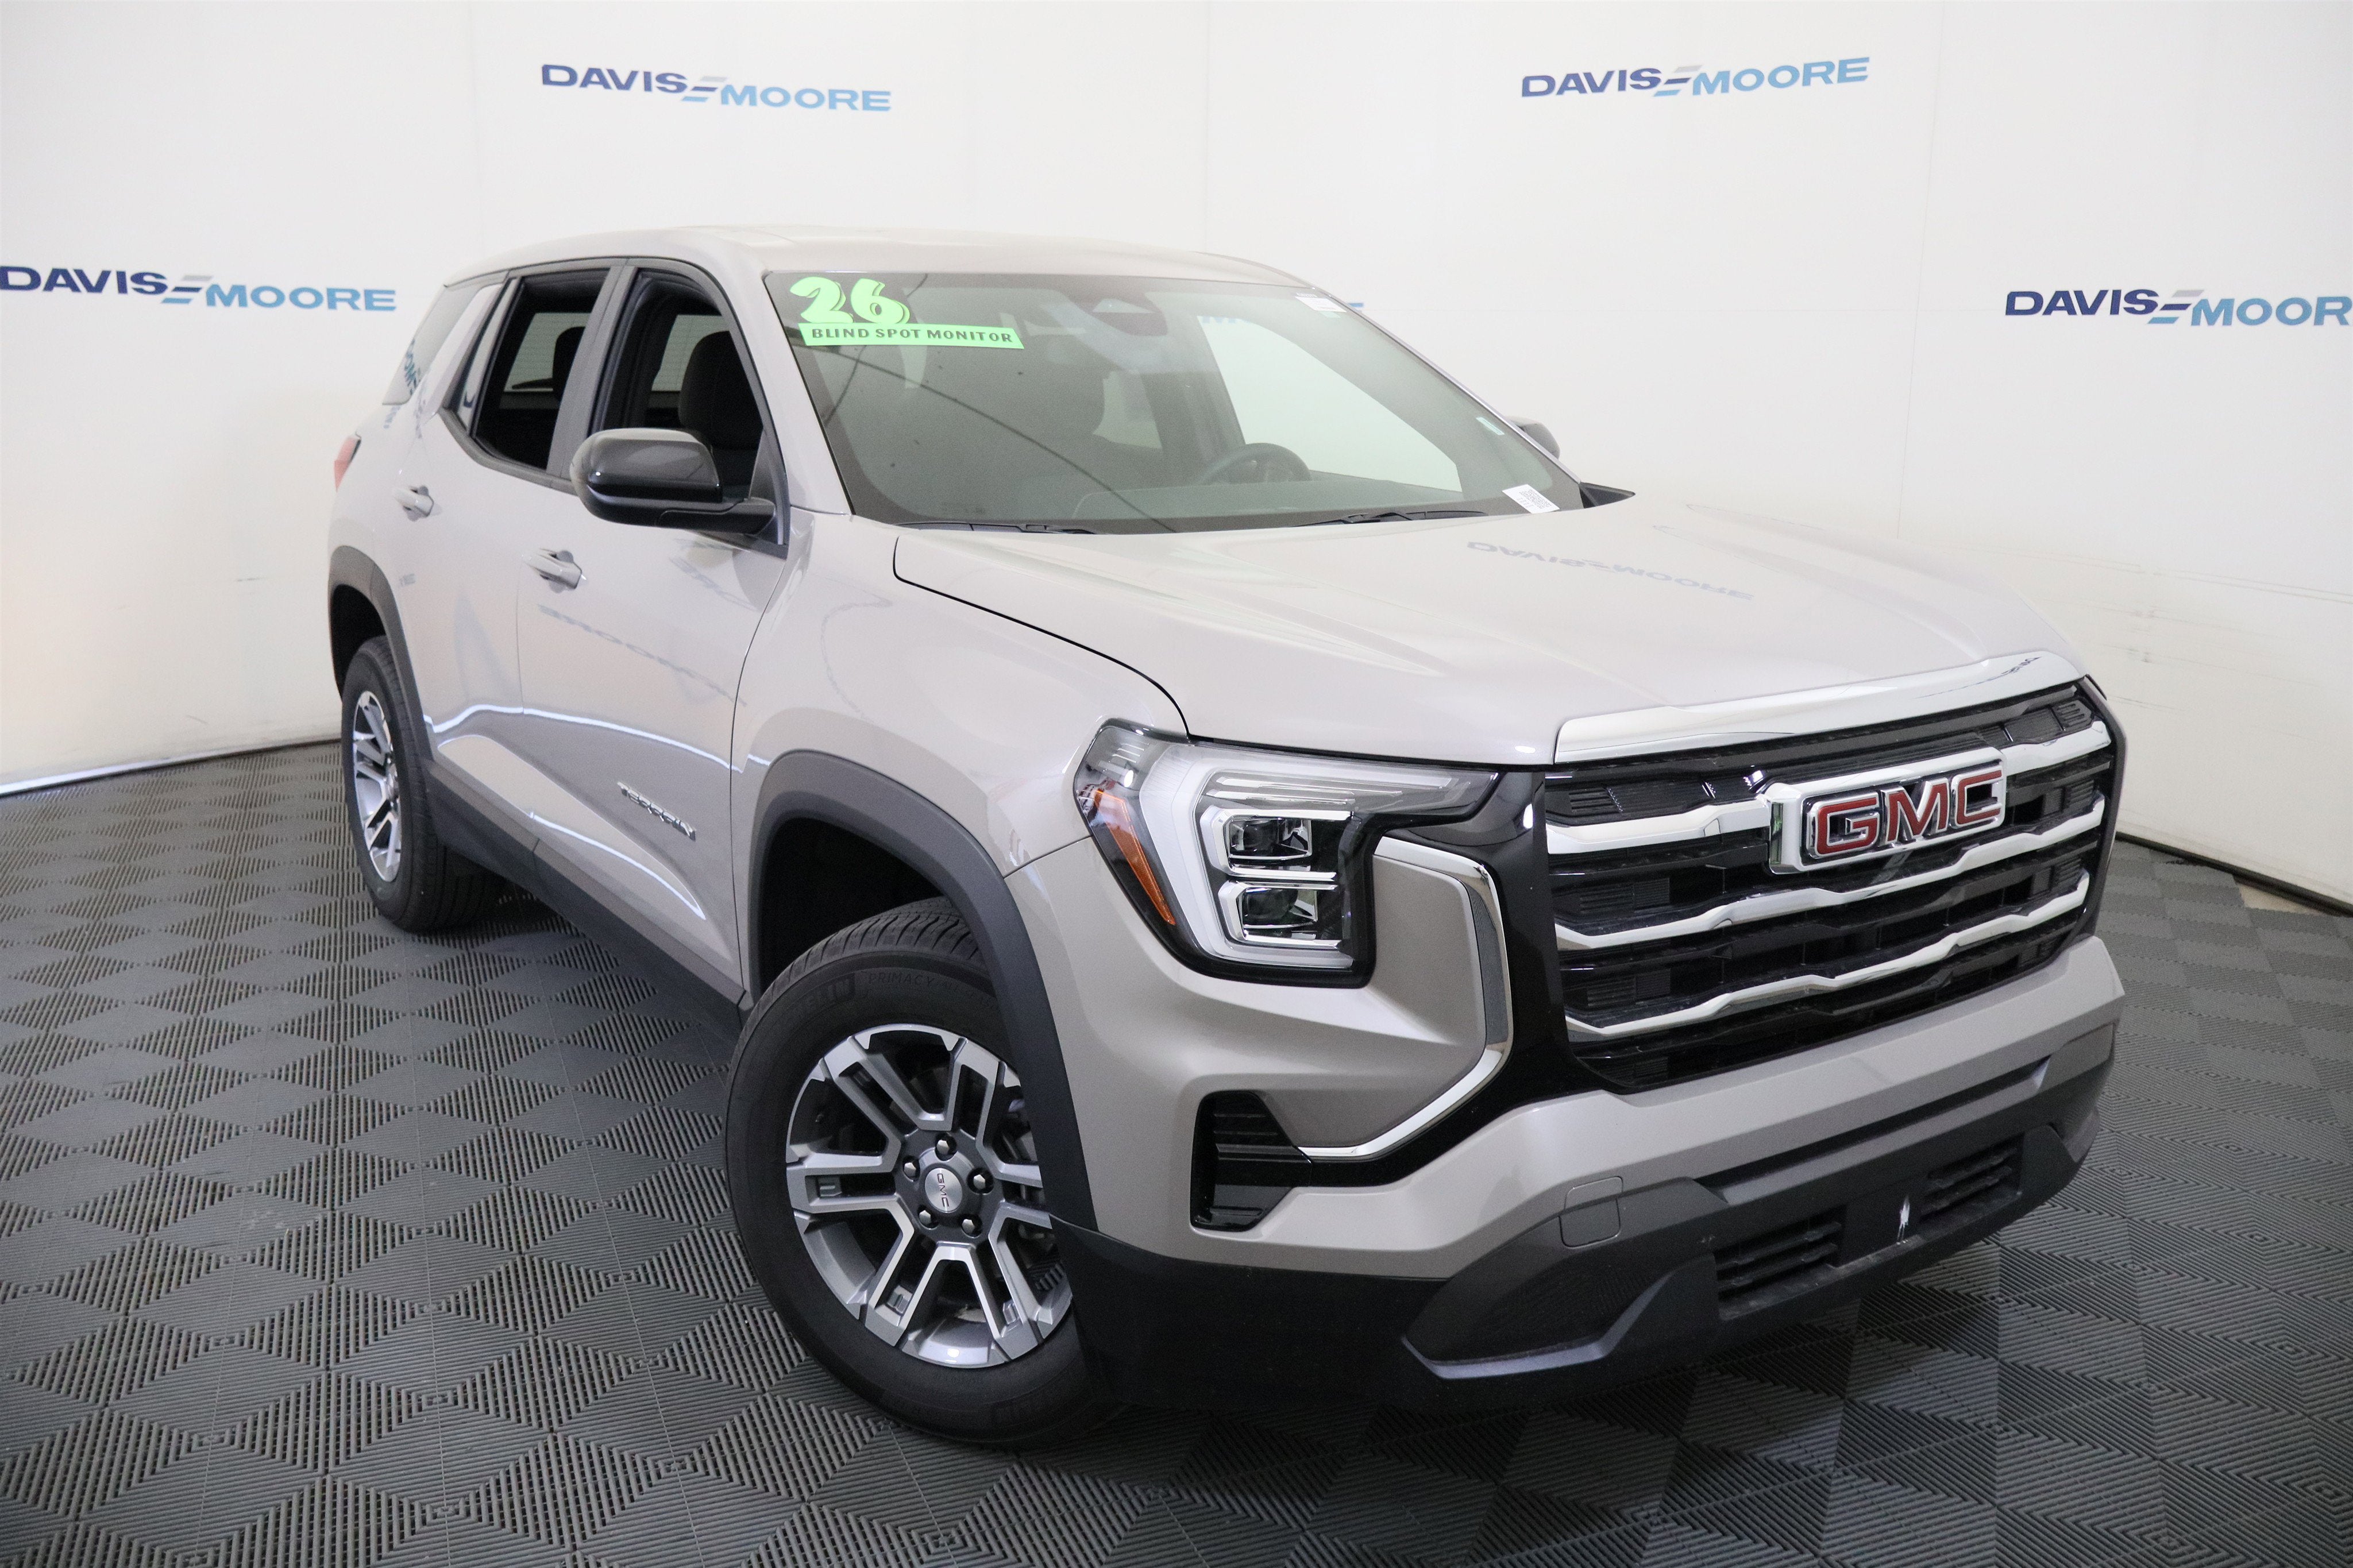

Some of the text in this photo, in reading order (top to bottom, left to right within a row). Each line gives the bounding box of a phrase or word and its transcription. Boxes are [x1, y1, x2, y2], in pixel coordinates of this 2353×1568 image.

[542, 64, 891, 111] DAVIS MOORE
[1521, 56, 1869, 97] DAVIS MOORE
[0, 265, 396, 311] DAVIS MOORE
[790, 276, 911, 324] 26
[2005, 289, 2353, 326] DAVIS MOOR
[812, 328, 1013, 343] BLIND SPOT MONITOR
[1808, 766, 2003, 859] GMC
[937, 1173, 950, 1207] GMC
